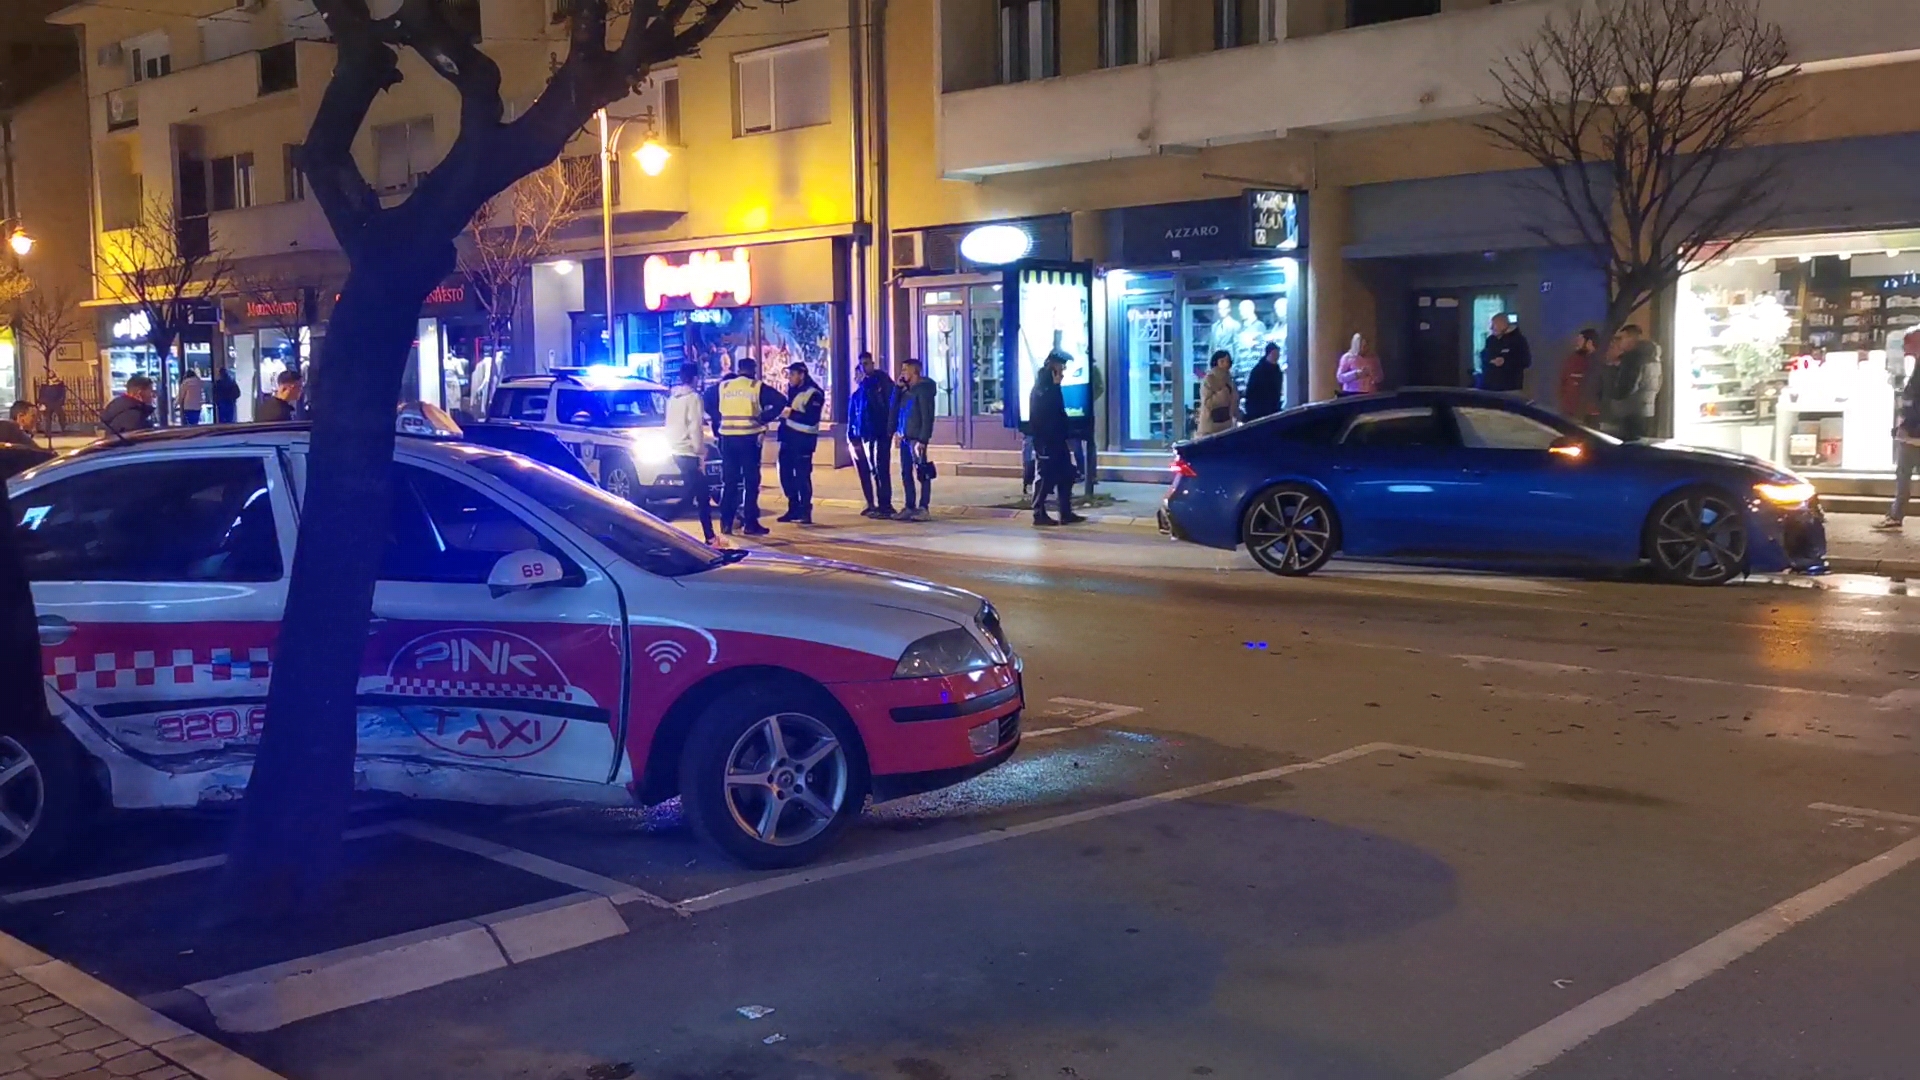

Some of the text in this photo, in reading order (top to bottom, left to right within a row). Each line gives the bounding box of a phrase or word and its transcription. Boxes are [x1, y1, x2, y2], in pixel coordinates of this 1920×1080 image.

[1164, 225, 1219, 239] AZZARO
[522, 563, 544, 578] 69
[415, 637, 537, 677] PINK
[424, 708, 541, 749] TAXI
